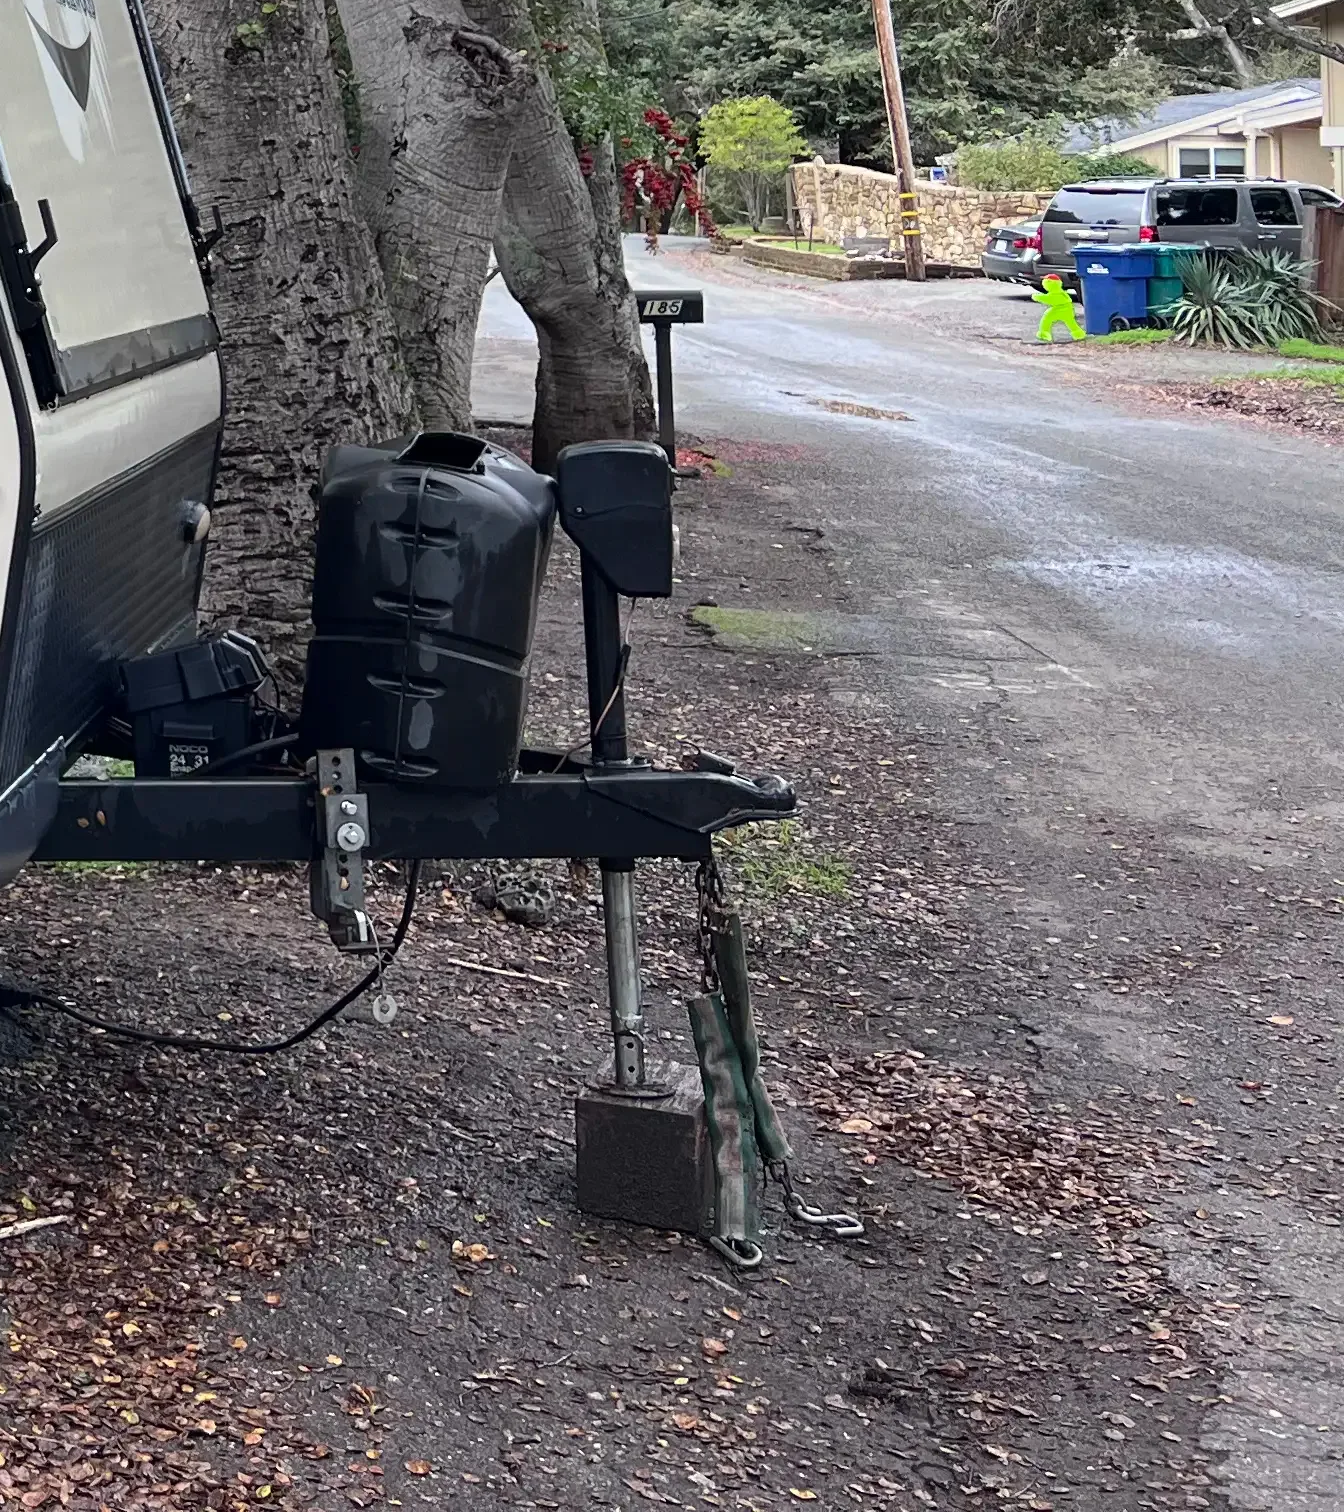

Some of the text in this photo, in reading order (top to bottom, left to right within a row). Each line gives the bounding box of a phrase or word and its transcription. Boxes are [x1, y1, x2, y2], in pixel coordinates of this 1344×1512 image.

[648, 301, 680, 314] 185
[169, 744, 208, 754] NOCO
[170, 754, 186, 765] 24
